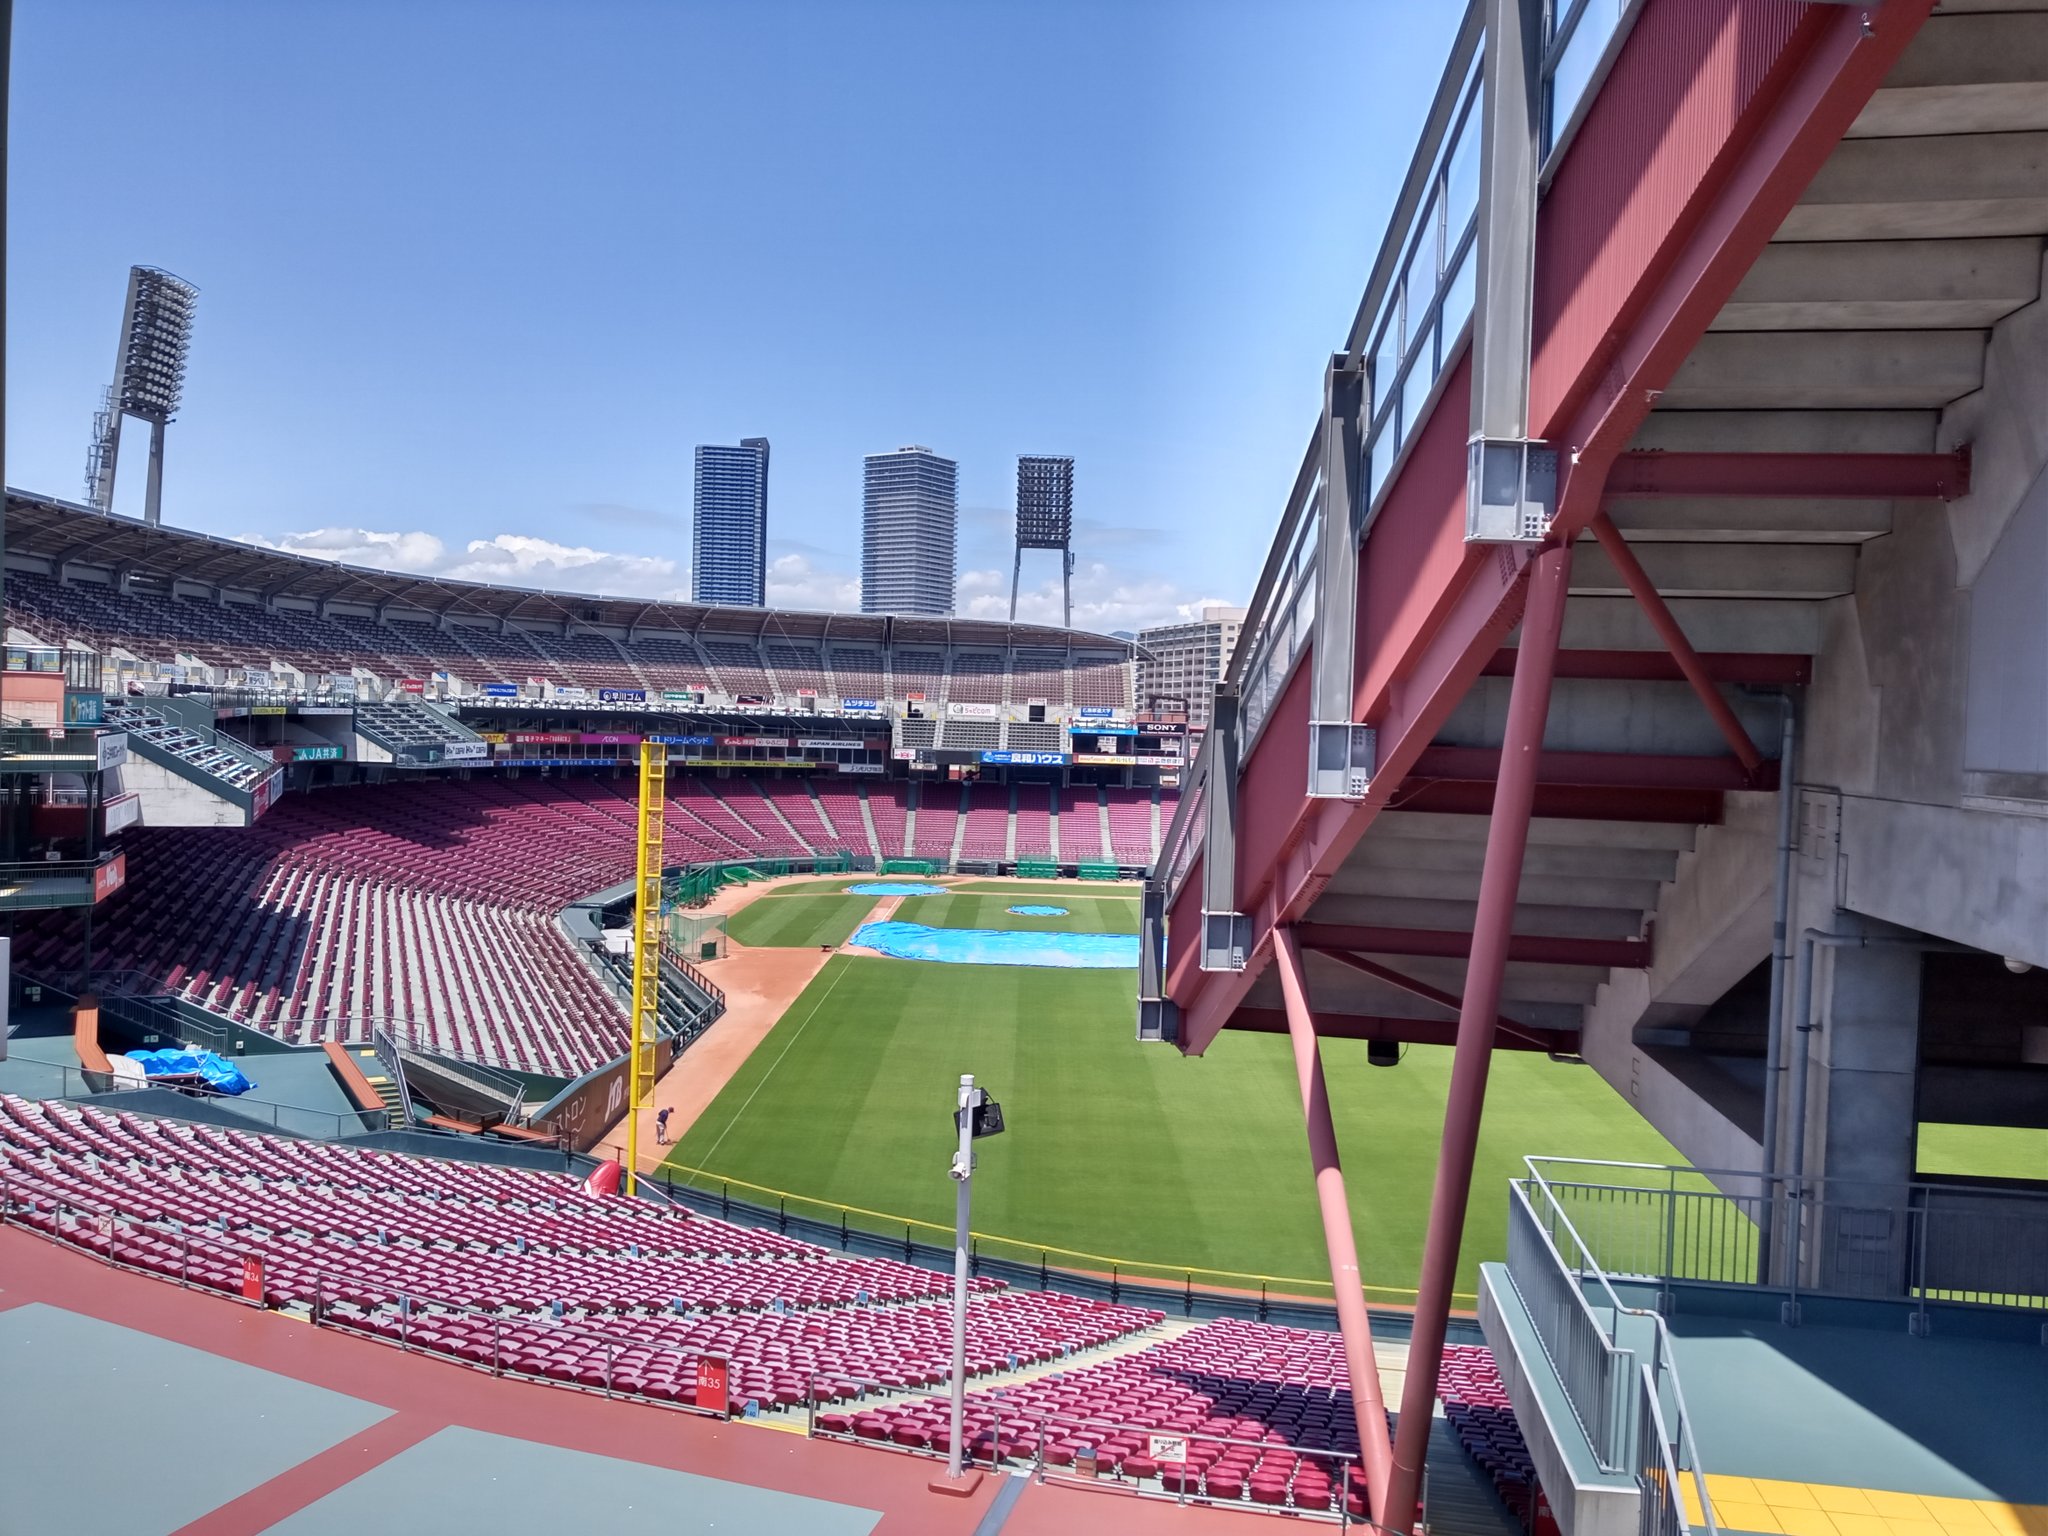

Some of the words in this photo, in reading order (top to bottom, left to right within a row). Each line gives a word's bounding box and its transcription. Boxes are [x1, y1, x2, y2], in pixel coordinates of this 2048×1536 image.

[612, 692, 641, 701] 早川ゴム
[664, 737, 709, 745] ドリームベッド
[309, 748, 337, 760] JA共済
[1011, 753, 1064, 764] 良和ハウス
[698, 1376, 720, 1389] 南35
